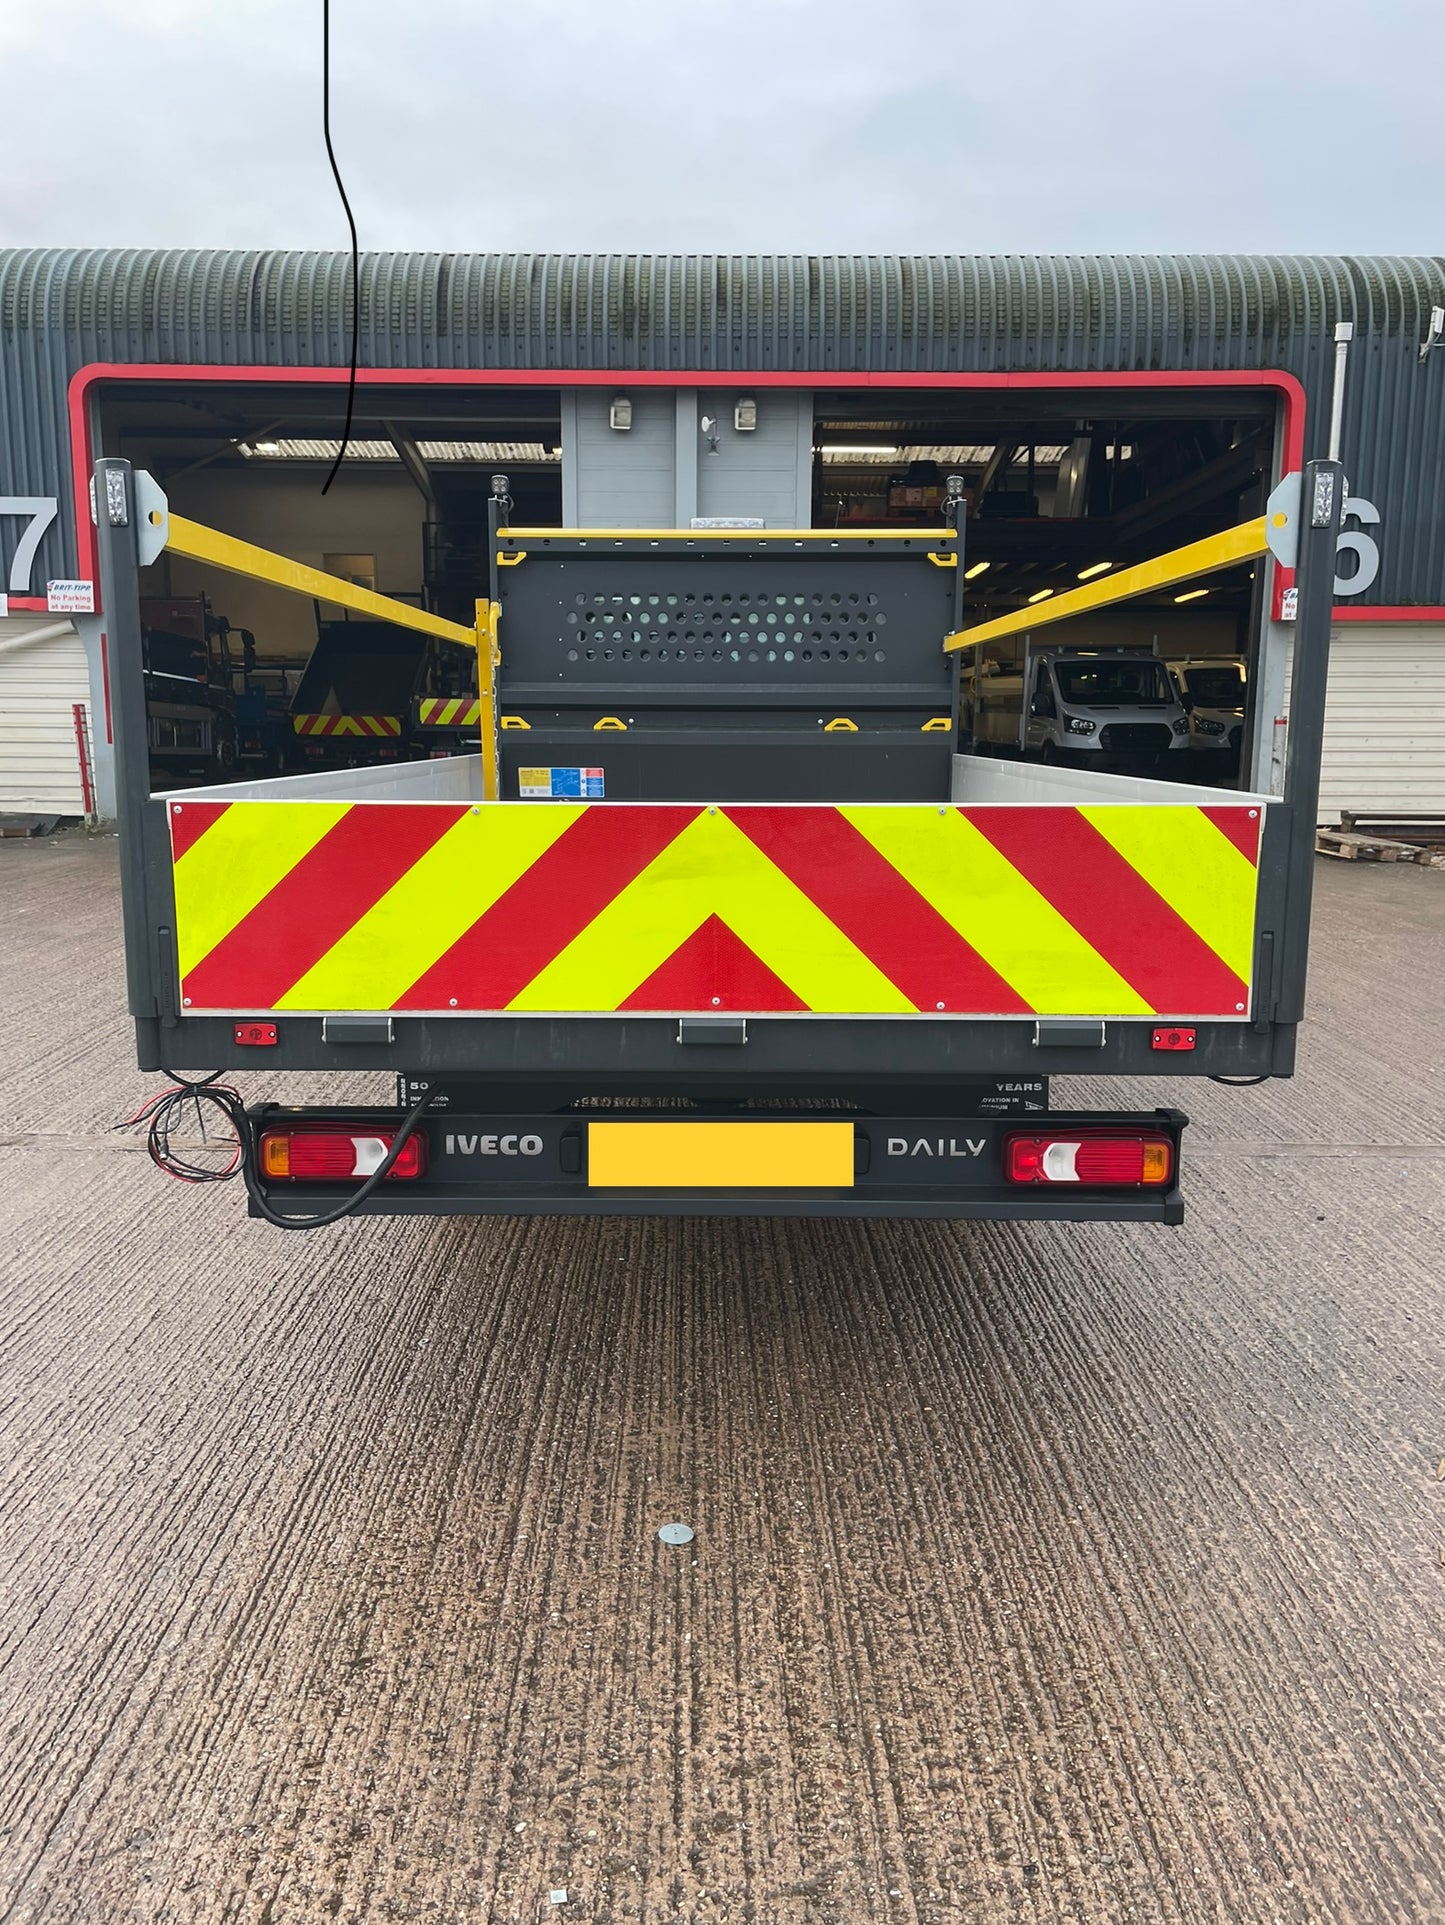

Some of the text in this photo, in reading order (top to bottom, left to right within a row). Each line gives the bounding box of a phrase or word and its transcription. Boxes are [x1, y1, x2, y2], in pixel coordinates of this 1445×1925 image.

[0, 497, 57, 591] 7
[1333, 497, 1381, 596] 6
[63, 594, 91, 603] Parking
[60, 604, 73, 612] any
[410, 1081, 429, 1090] 50
[996, 1083, 1043, 1091] YEARS
[445, 1134, 544, 1156] IVECO
[887, 1137, 987, 1157] DAILY
